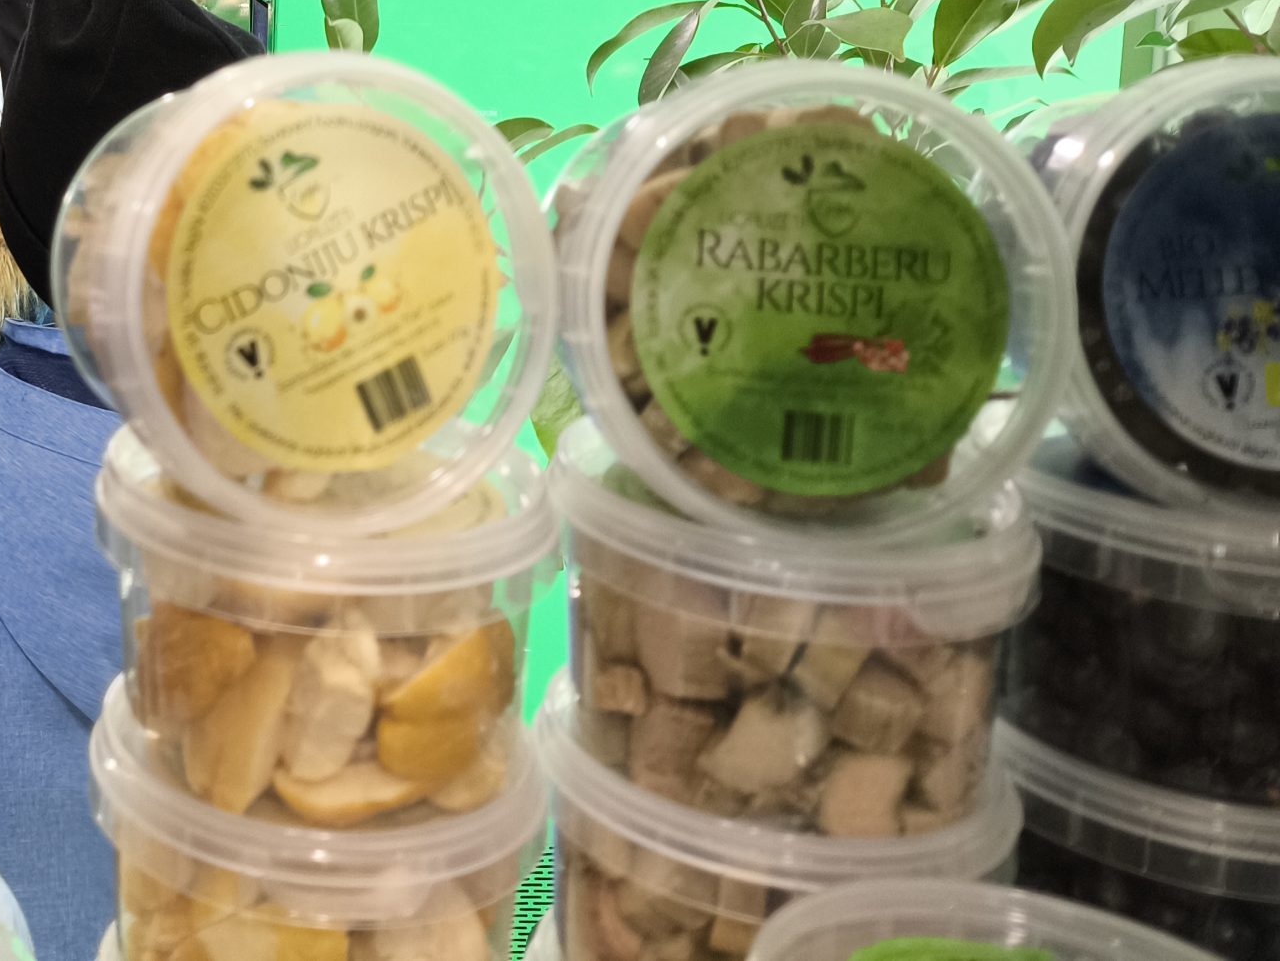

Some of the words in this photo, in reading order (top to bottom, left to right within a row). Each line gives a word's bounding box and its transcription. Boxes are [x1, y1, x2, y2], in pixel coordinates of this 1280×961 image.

[192, 233, 361, 335] CIDONIJU
[360, 177, 454, 250] KRISPI
[696, 227, 953, 285] RABARBERU
[756, 277, 885, 320] KRISPI
